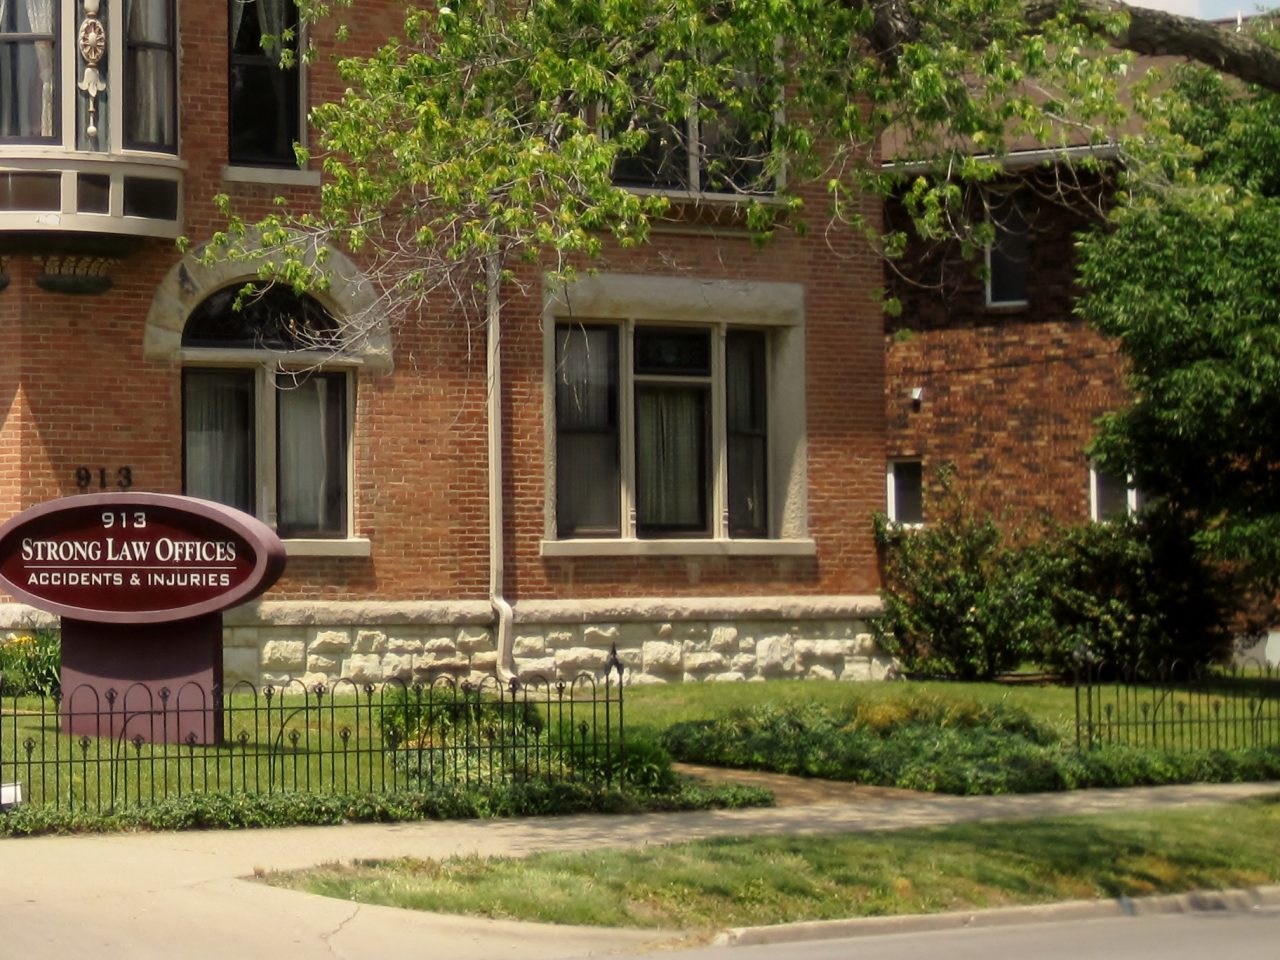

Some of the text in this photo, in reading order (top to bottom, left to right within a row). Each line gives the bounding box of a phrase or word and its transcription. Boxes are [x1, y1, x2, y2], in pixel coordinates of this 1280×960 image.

[75, 466, 133, 490] 913
[101, 512, 147, 529] 913
[21, 537, 237, 563] STRONG LAW OFFICES
[27, 572, 231, 587] ACCIDENTS & INJURIES
